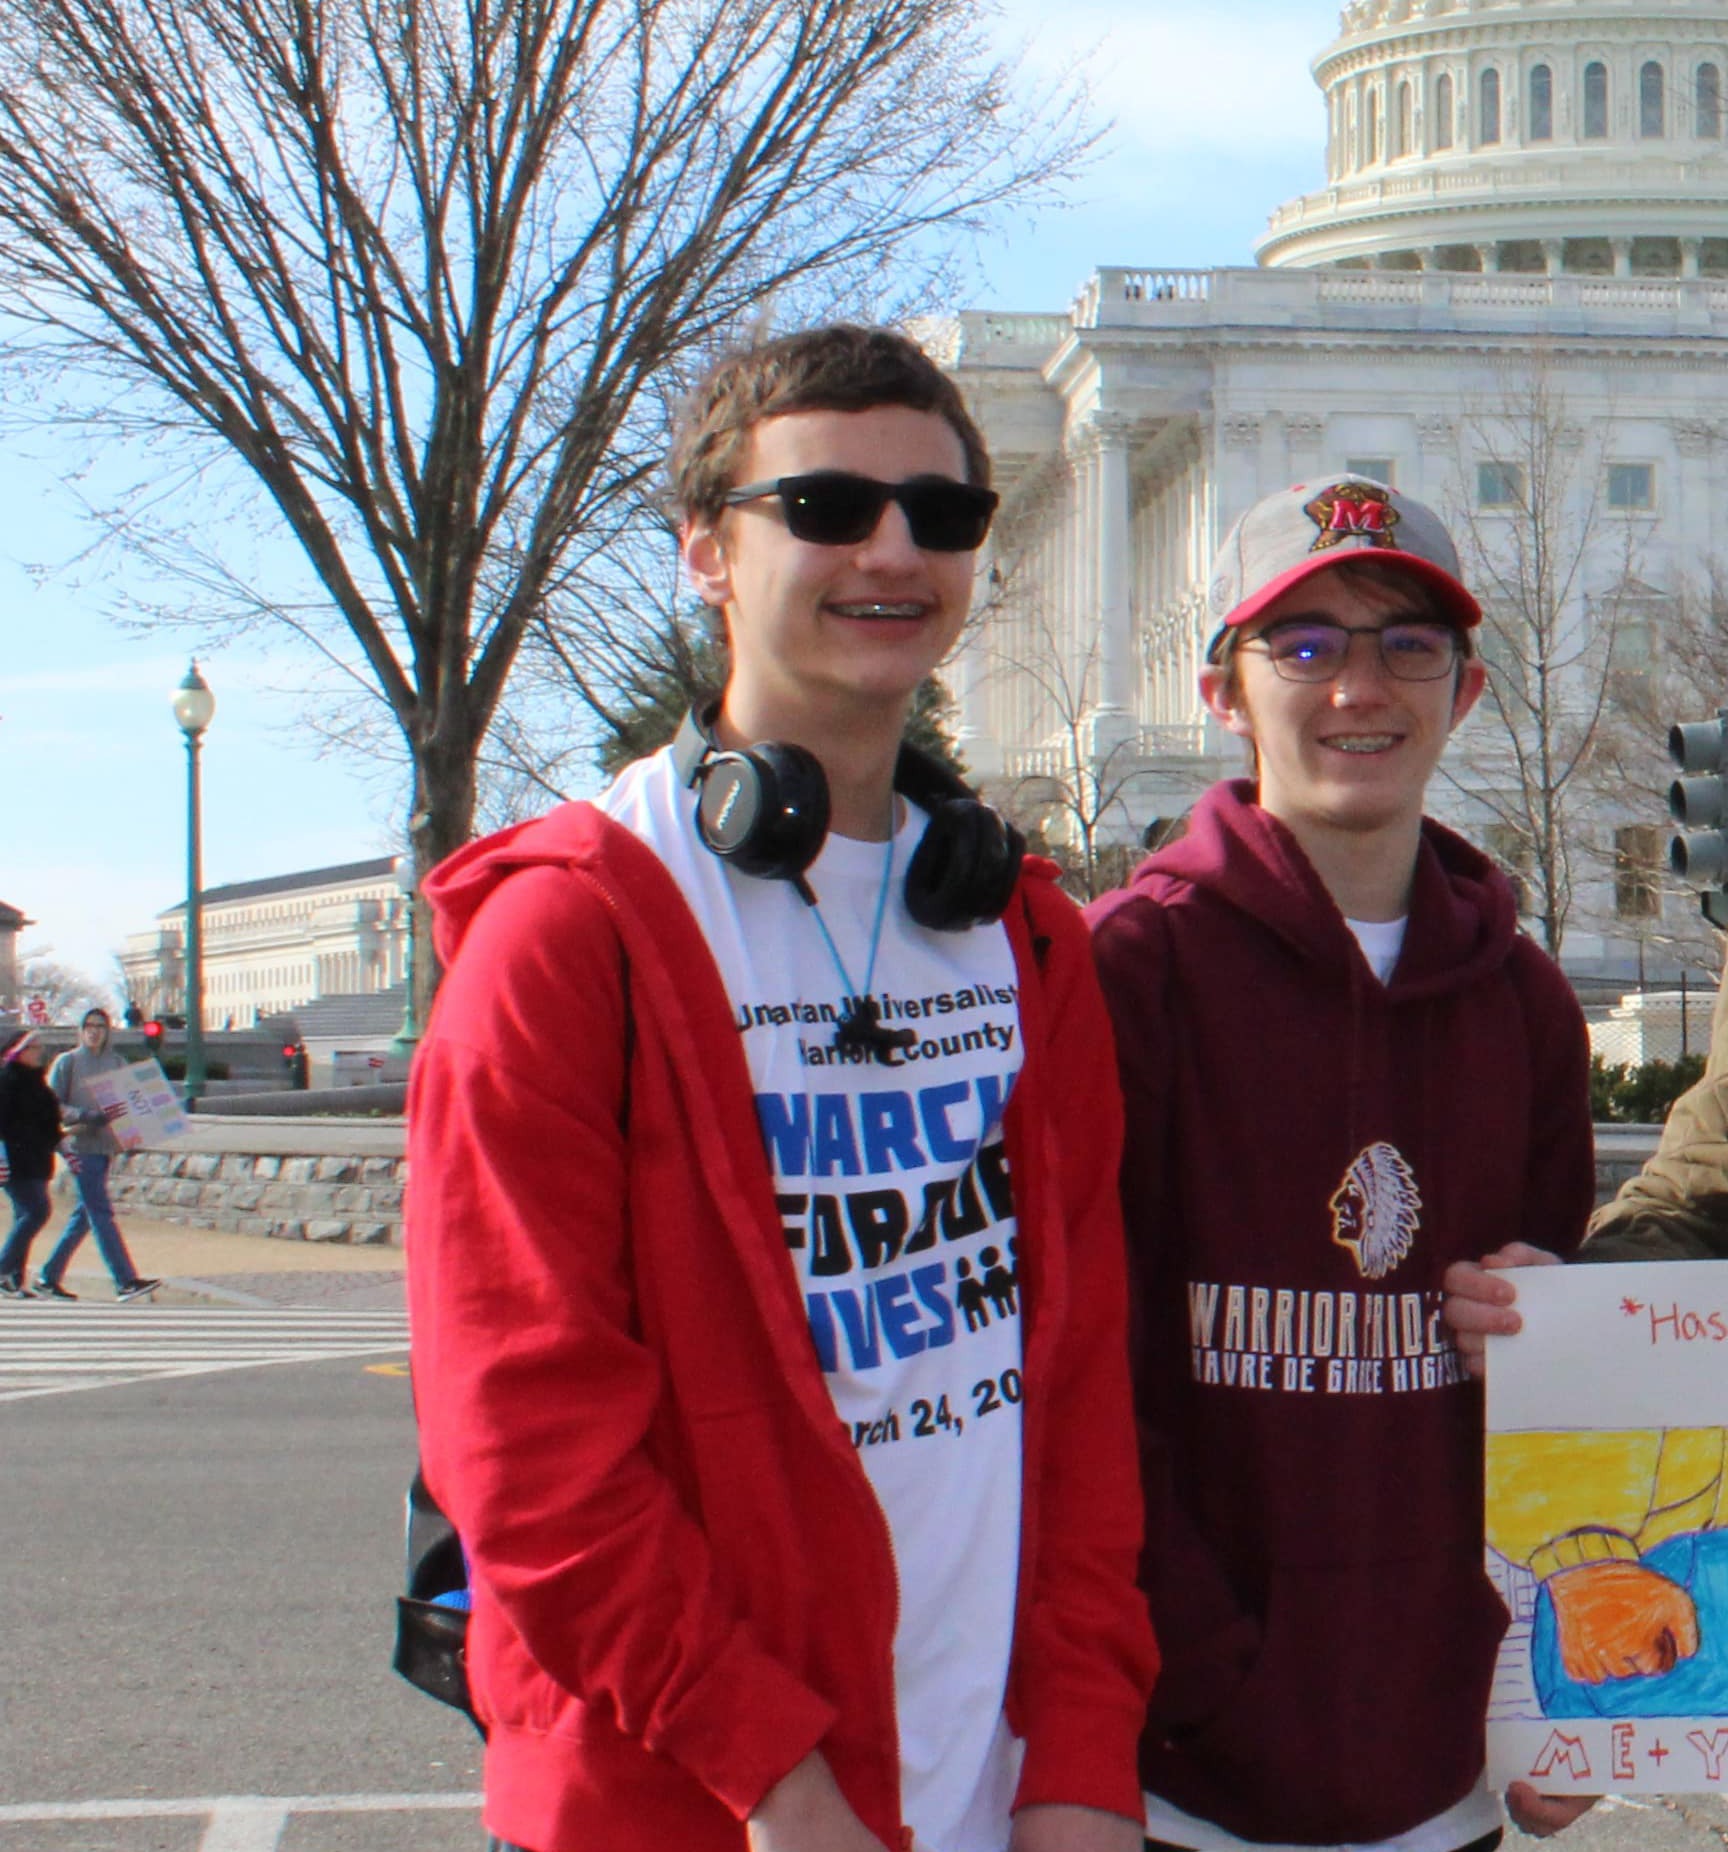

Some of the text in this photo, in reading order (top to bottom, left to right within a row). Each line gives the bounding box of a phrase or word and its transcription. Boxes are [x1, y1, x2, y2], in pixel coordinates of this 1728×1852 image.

[1330, 499, 1385, 533] M
[805, 1260, 956, 1373] IVES
[1188, 1281, 1357, 1358] WARRIOR
[910, 1393, 963, 1438] 24,
[972, 1367, 1023, 1418] 20
[1283, 1356, 1316, 1393] DE
[1529, 1722, 1636, 1781] ME
